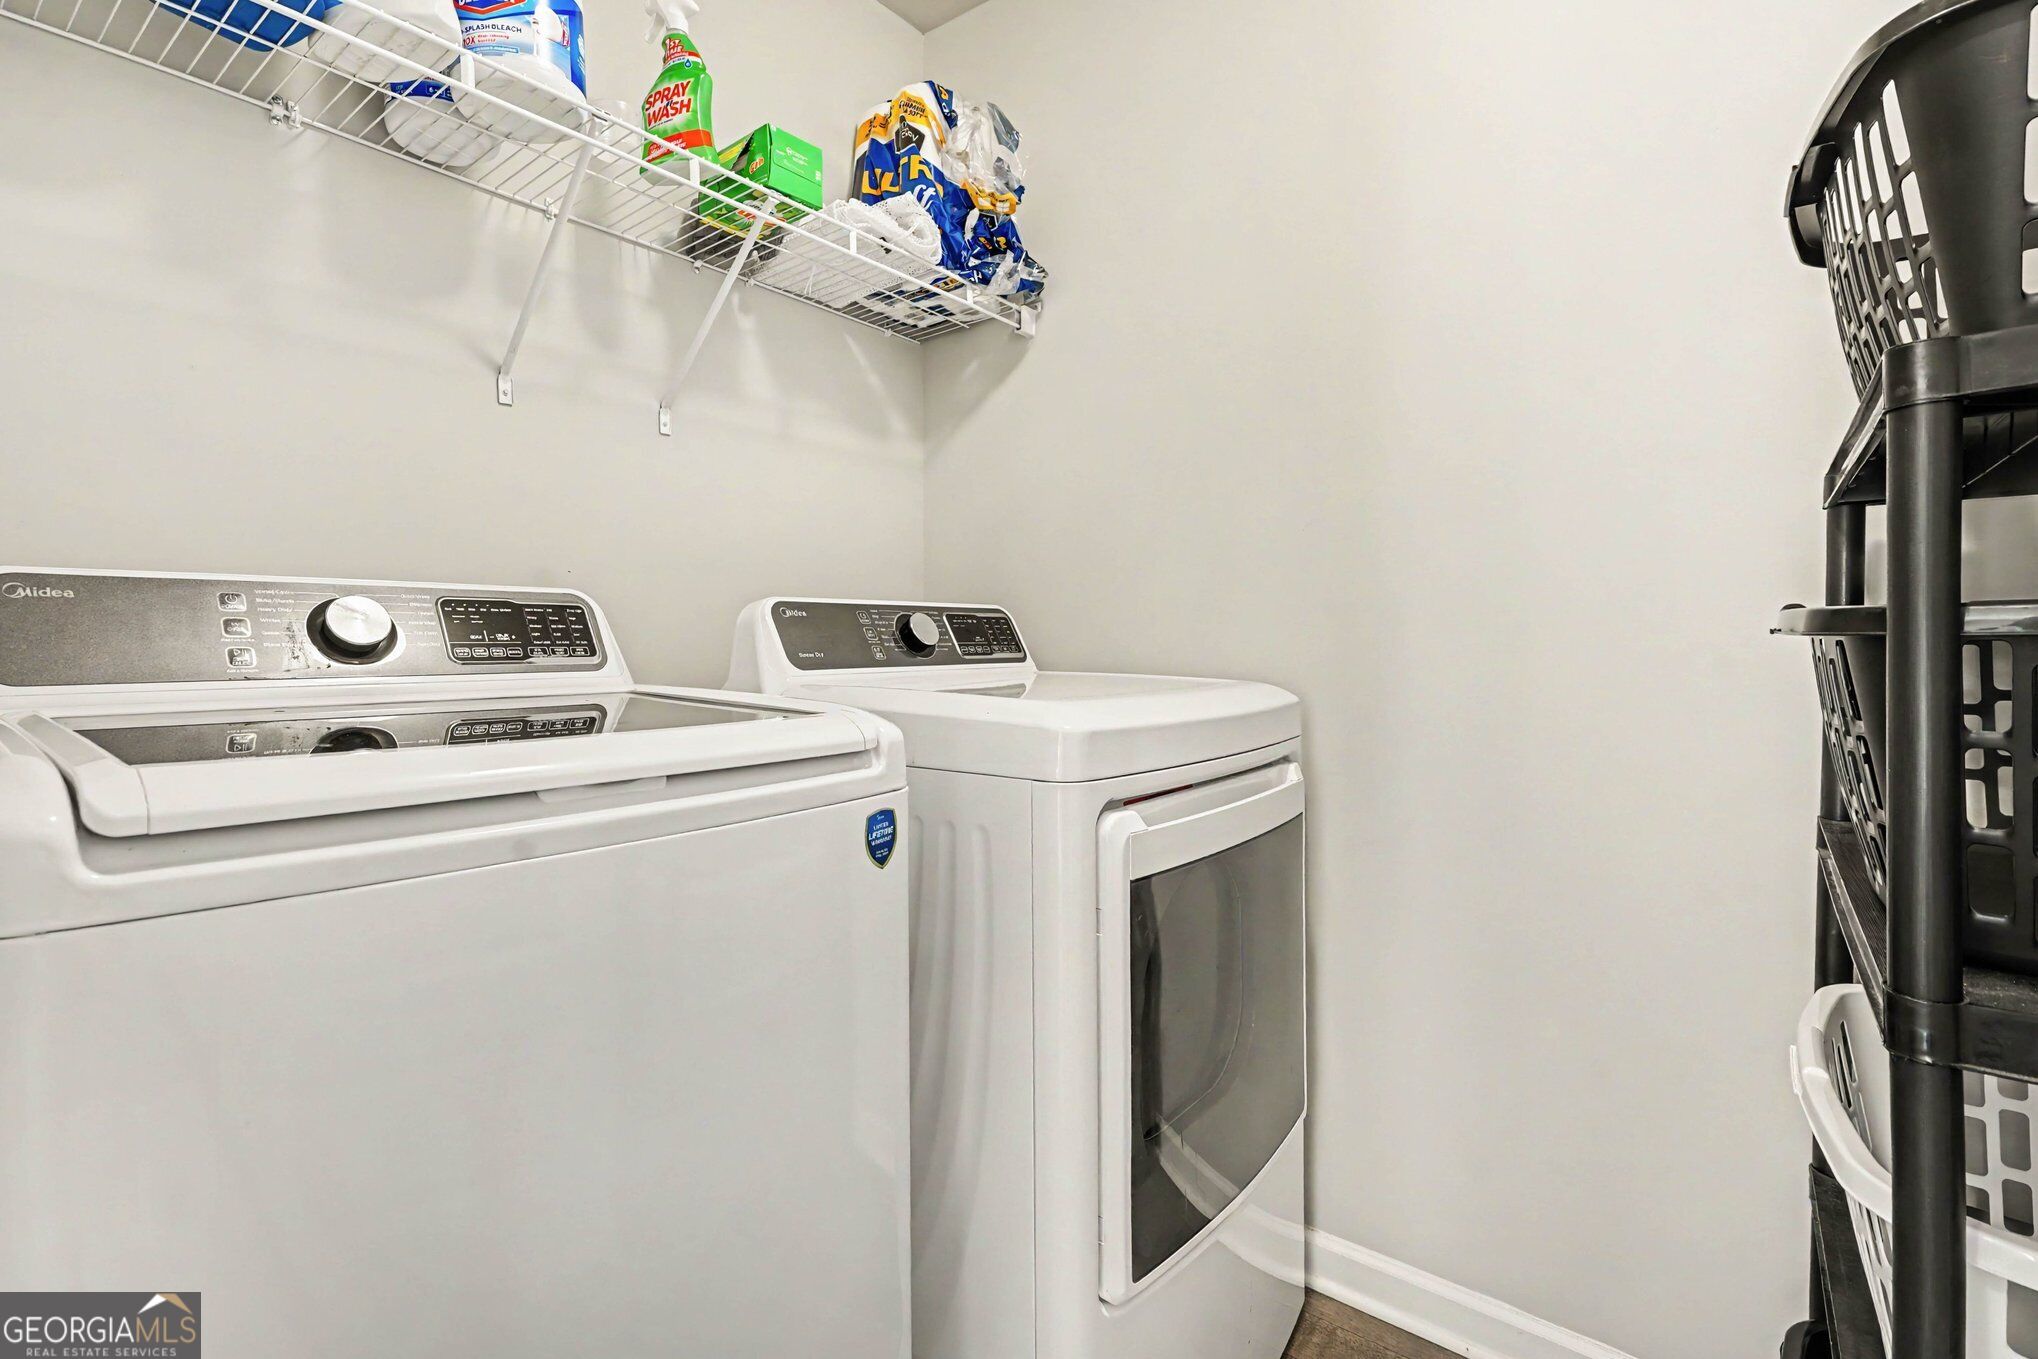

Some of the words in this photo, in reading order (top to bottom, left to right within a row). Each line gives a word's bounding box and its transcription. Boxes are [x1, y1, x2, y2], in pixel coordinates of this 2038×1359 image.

[491, 23, 522, 34] BLEACH
[645, 80, 691, 111] SPRAY
[647, 97, 692, 127] WASH
[2, 582, 75, 598] Midea
